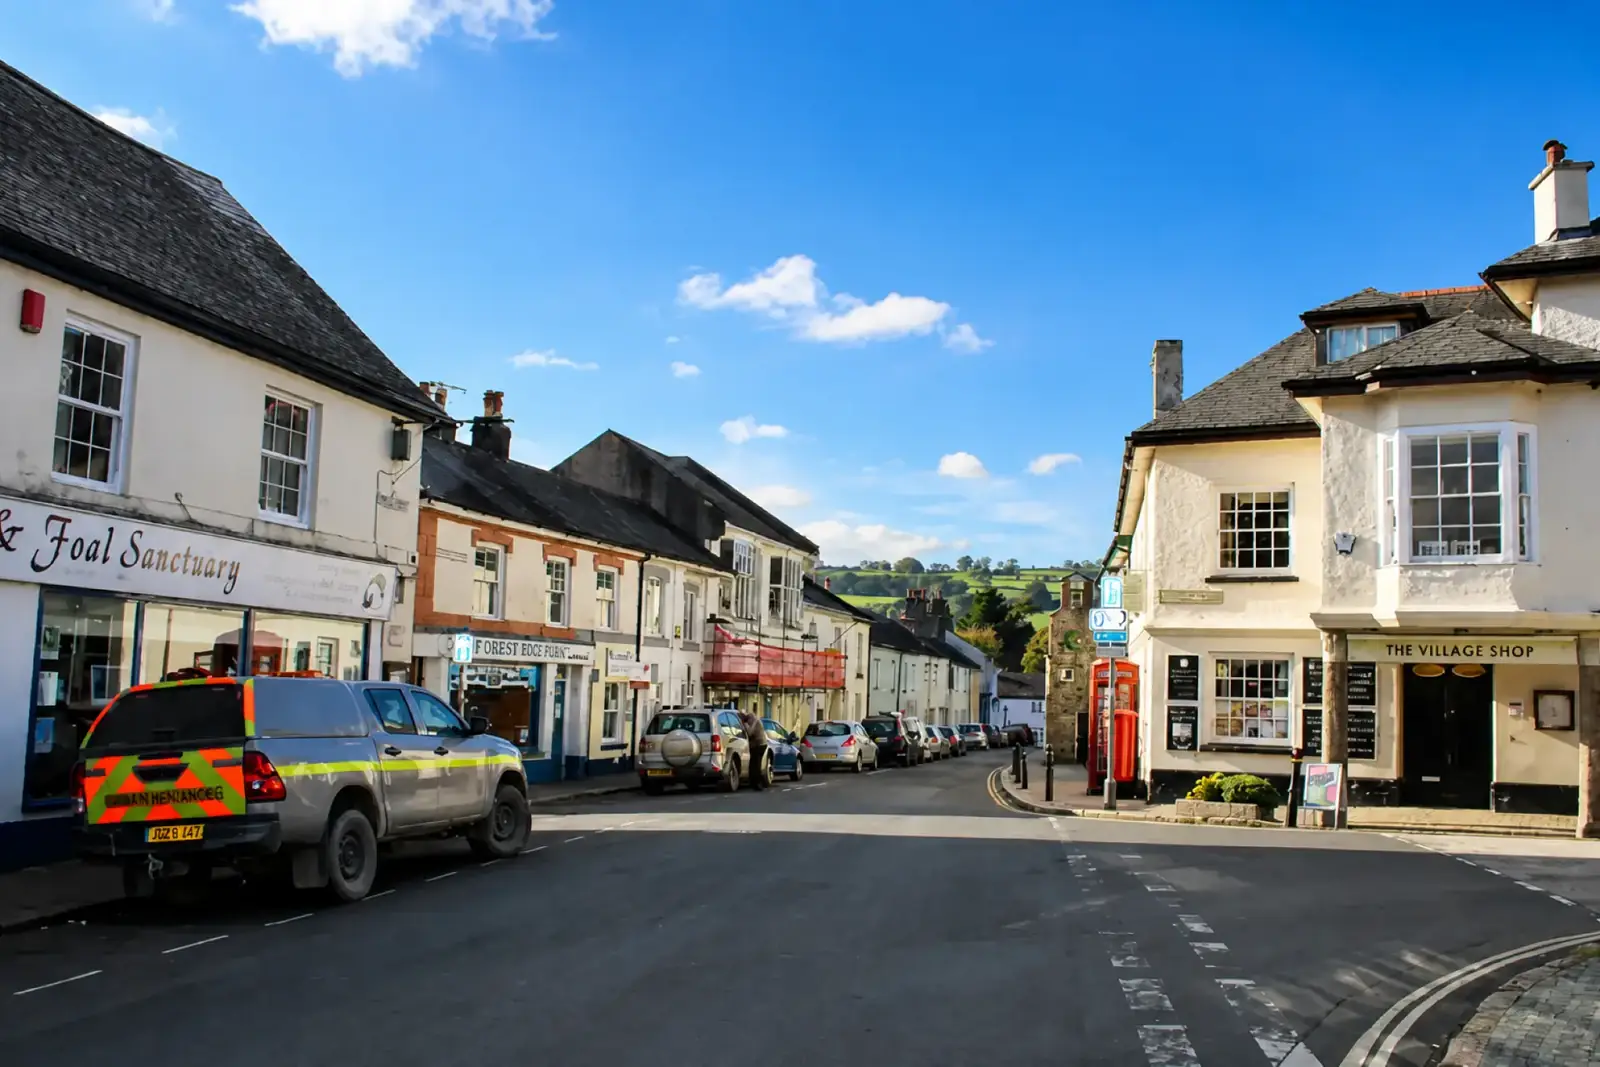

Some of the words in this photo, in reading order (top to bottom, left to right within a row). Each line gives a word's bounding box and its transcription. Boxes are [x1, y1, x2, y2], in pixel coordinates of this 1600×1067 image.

[0, 509, 24, 552] &
[31, 514, 114, 573] Foal
[119, 530, 240, 595] Sanctuary
[475, 640, 519, 657] FOREST
[1386, 644, 1413, 656] THE
[1418, 645, 1483, 657] VILLAGE
[1490, 645, 1534, 658] SHOP
